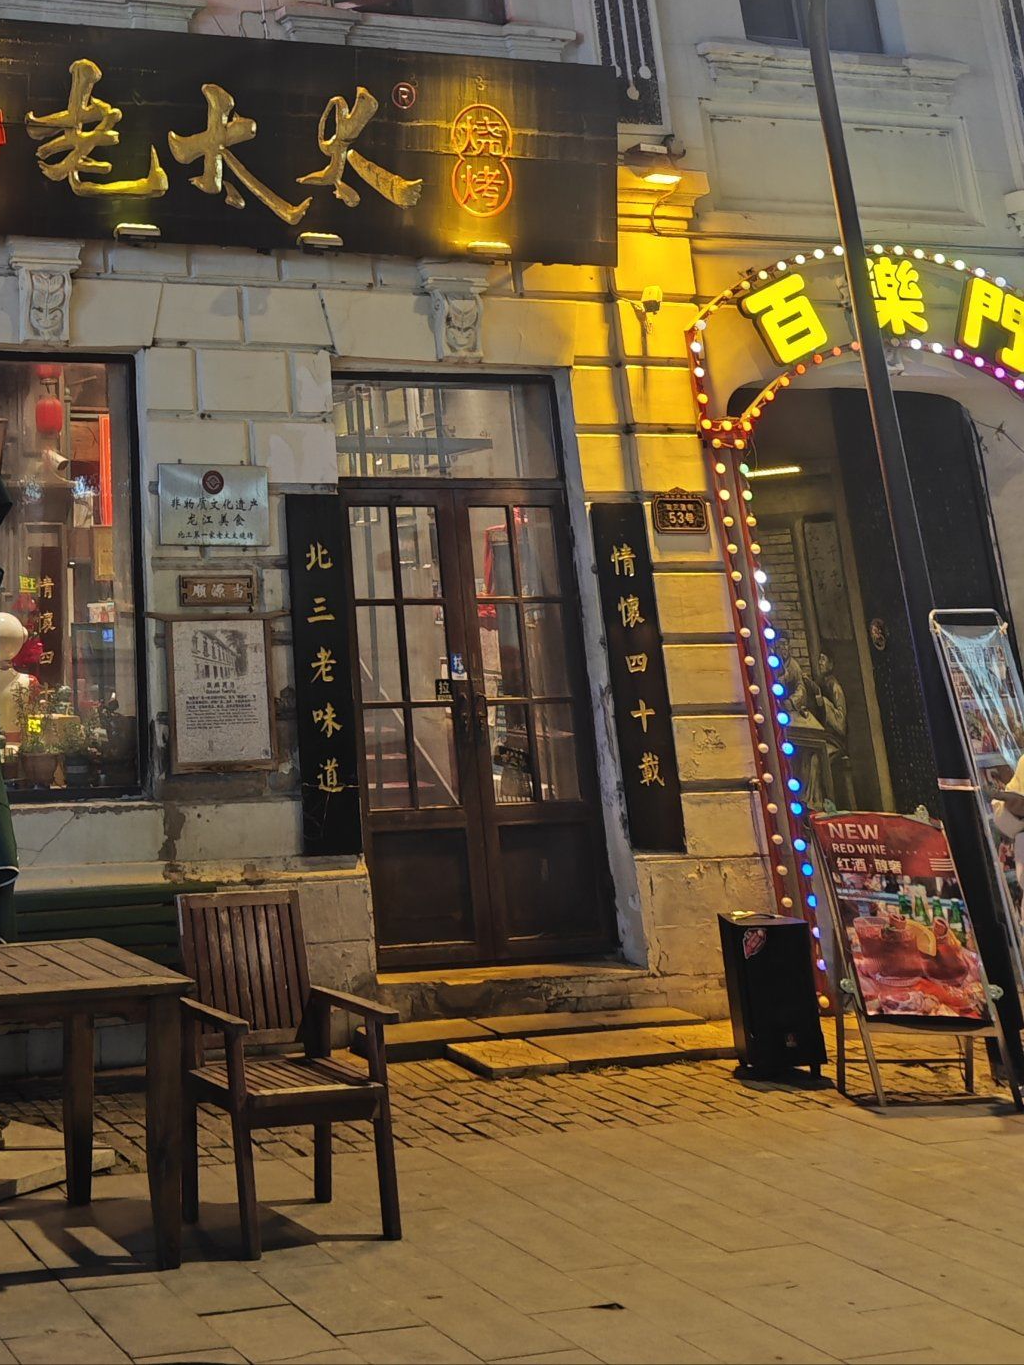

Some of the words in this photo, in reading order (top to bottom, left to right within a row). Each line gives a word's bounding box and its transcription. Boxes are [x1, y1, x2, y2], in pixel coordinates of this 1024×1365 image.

[461, 114, 508, 211] 烧烤
[742, 258, 1024, 373] 百樂門
[171, 496, 259, 512] 非物质文化遗产
[187, 513, 246, 527] 龙江美食
[669, 512, 695, 524] 53号
[305, 542, 344, 794] 北三老味道
[610, 544, 666, 788] 情懷四十載
[439, 681, 450, 694] 拉
[828, 823, 879, 840] NEW
[832, 843, 855, 854] RED
[856, 843, 887, 855] WINE
